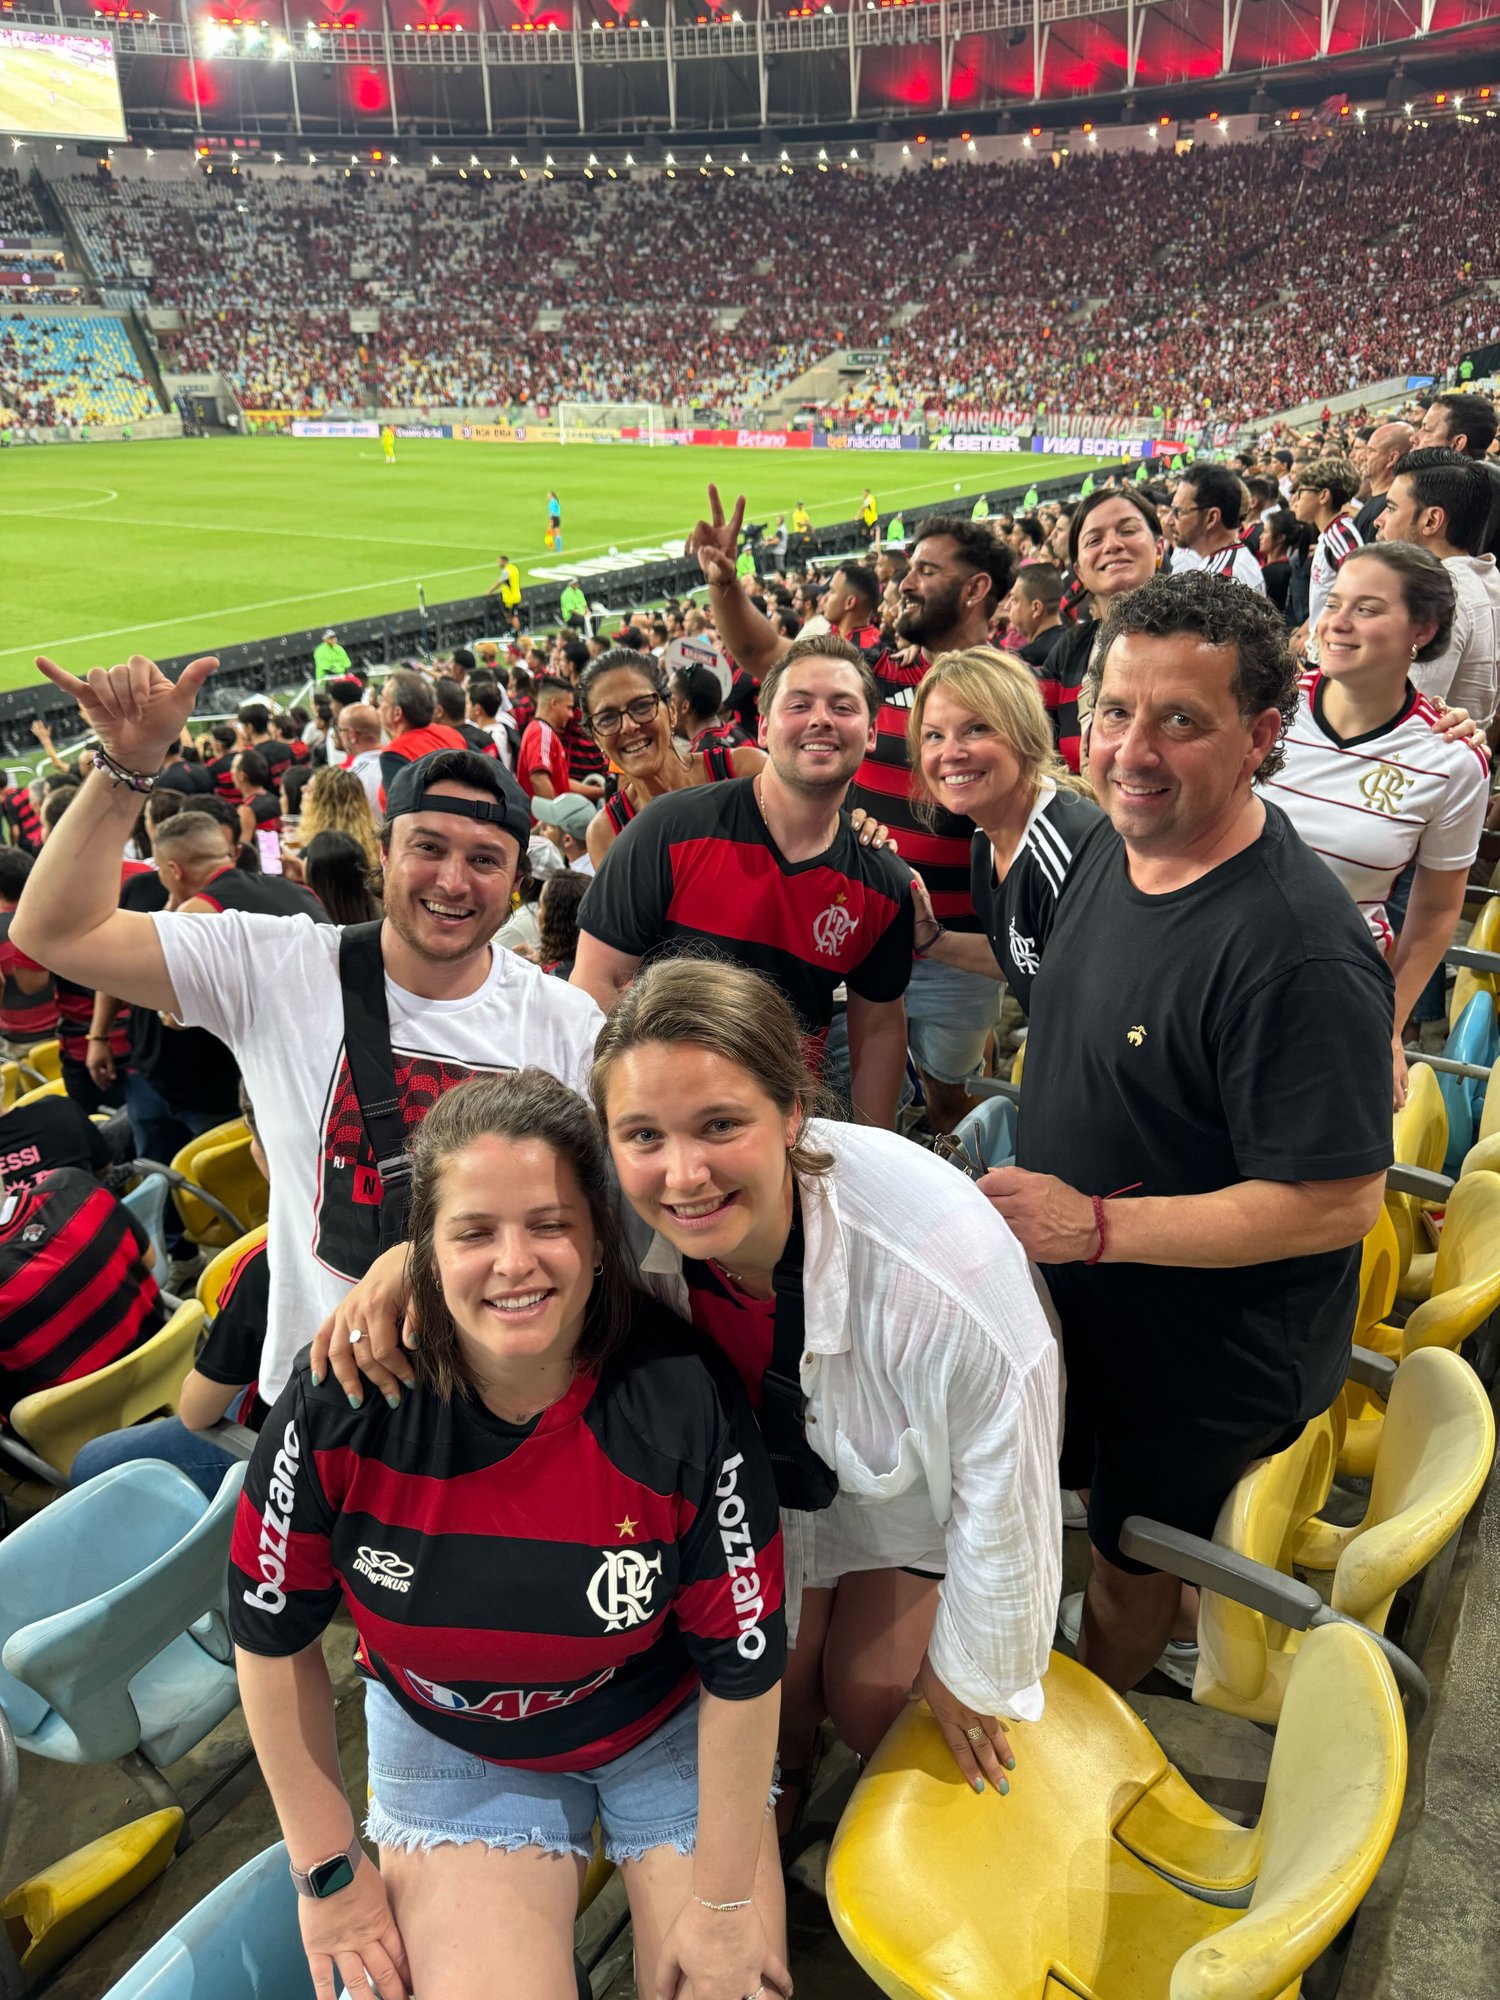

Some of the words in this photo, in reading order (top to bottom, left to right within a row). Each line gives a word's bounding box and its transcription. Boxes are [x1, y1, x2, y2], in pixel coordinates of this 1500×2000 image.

[736, 430, 787, 448] Betano
[827, 433, 901, 449] betnacional
[1042, 437, 1081, 455] VIVA
[1082, 438, 1144, 457] SORTE
[333, 1155, 346, 1169] RJ
[243, 1420, 300, 1614] bozzano
[715, 1452, 767, 1660] bozzano
[352, 1558, 412, 1593] OLYMPIKUS
